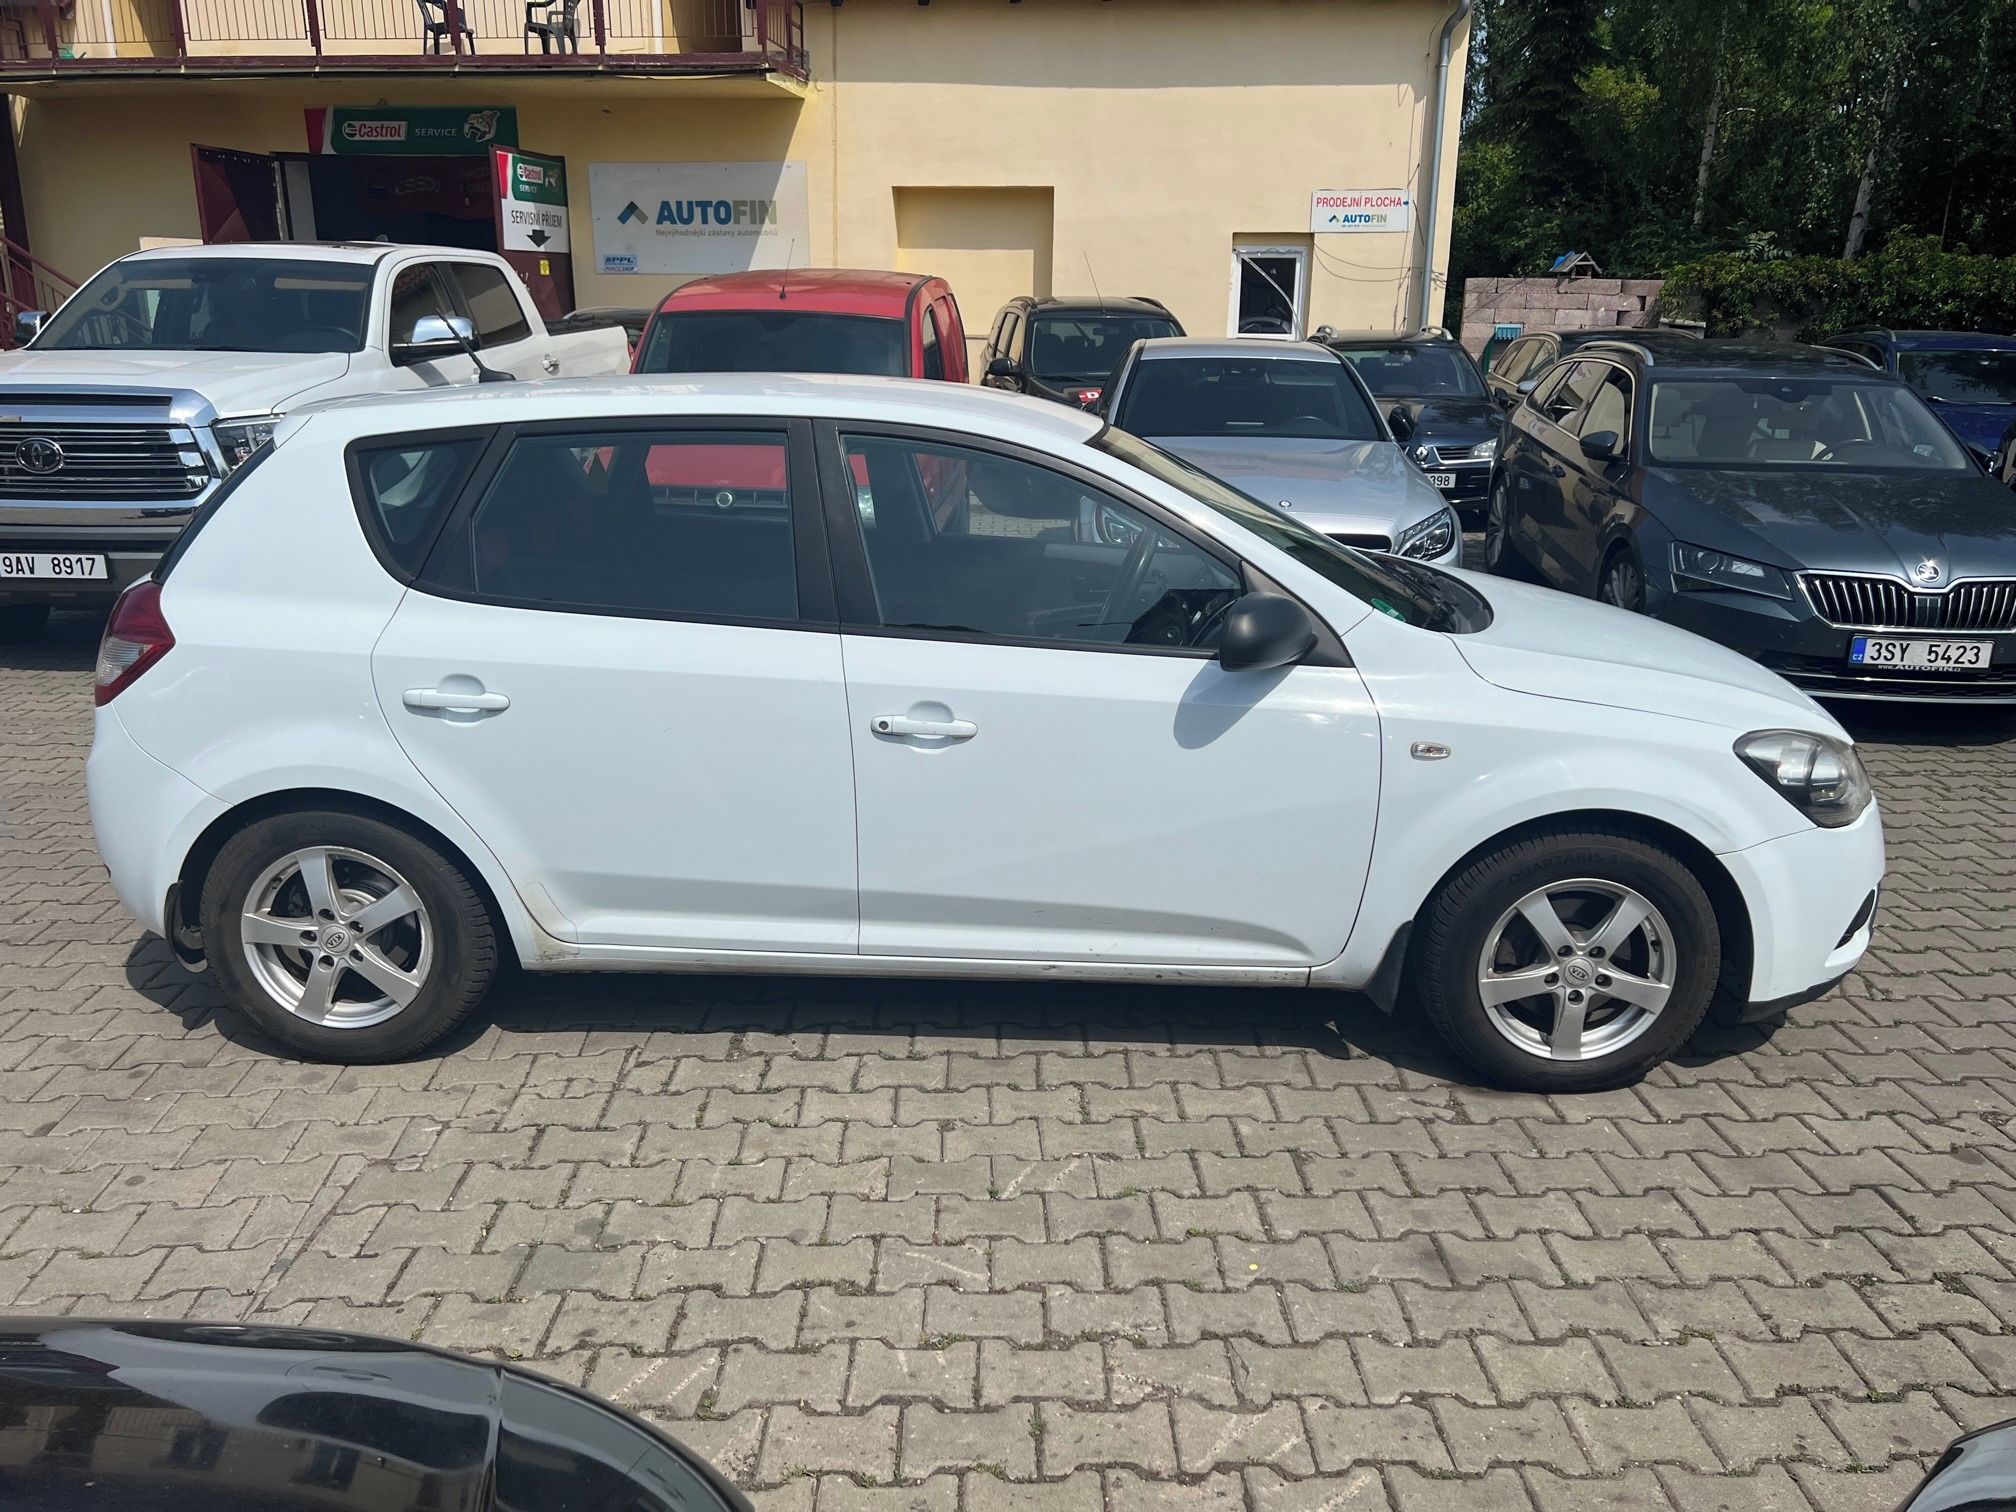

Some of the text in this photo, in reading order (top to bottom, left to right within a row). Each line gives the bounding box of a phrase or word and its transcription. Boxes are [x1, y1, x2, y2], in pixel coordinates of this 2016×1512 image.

[358, 123, 402, 138] Castrol
[415, 128, 457, 137] SERVICE
[523, 166, 542, 182] Castrol
[1316, 195, 1402, 208] PRODEJNÍ PLOCHA
[656, 200, 778, 225] AUTOFIN
[1343, 214, 1387, 223] AUTOFIN
[708, 229, 735, 238] zástavy
[2, 556, 96, 576] 9AV 8917
[1869, 642, 1981, 665] 3SY 5423
